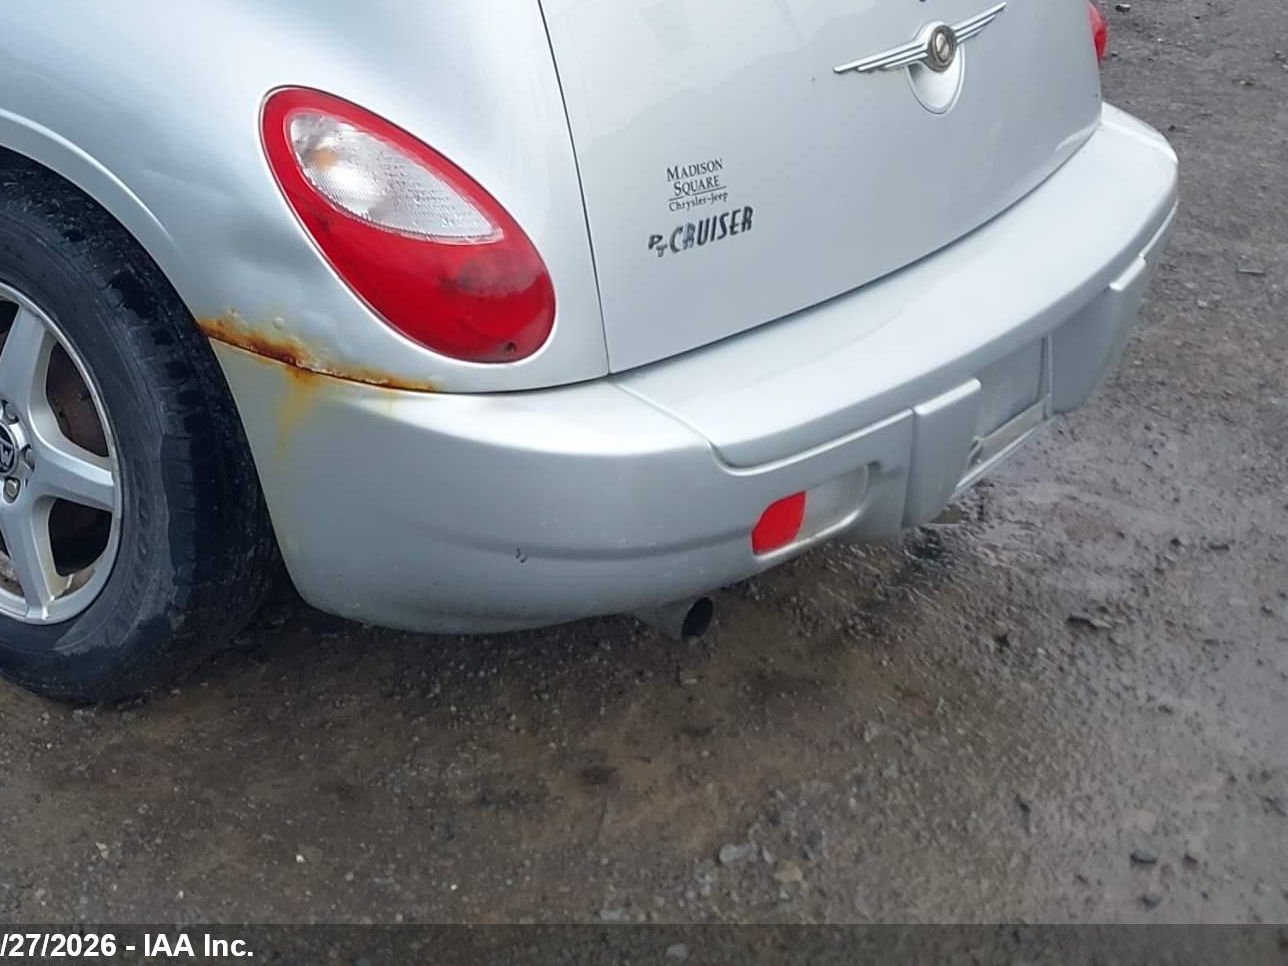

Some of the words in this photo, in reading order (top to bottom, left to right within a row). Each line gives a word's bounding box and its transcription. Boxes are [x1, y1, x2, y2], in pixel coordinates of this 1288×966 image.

[666, 158, 724, 182] MADISON
[673, 175, 720, 196] SQUARE
[669, 205, 754, 253] CRUISER
